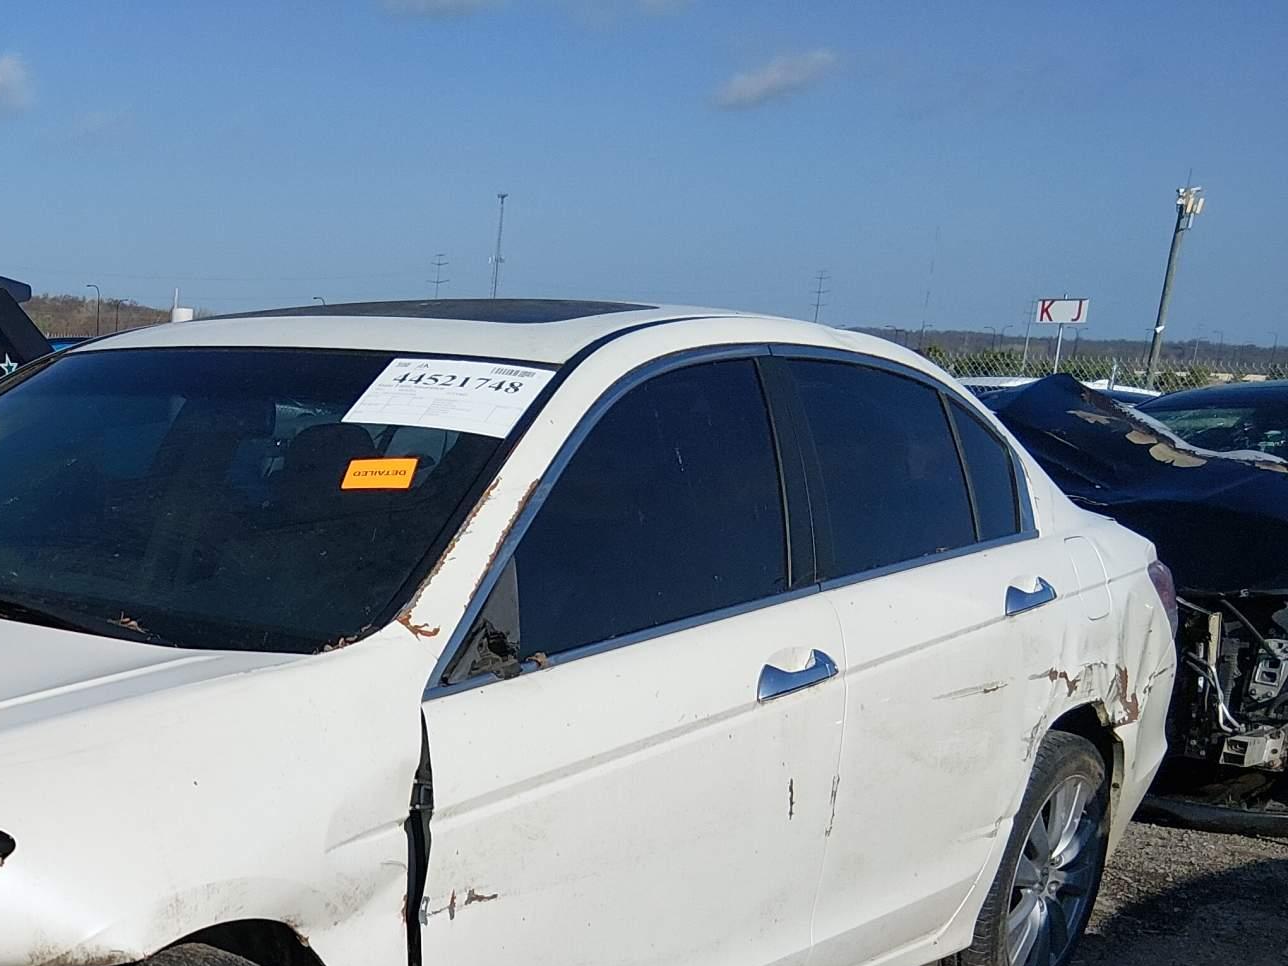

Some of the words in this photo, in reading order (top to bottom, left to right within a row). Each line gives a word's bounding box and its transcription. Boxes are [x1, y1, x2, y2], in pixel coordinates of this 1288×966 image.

[1040, 300, 1054, 322] K
[1071, 300, 1083, 322] J
[393, 372, 523, 394] 44521748
[352, 469, 407, 477] DETAILED
